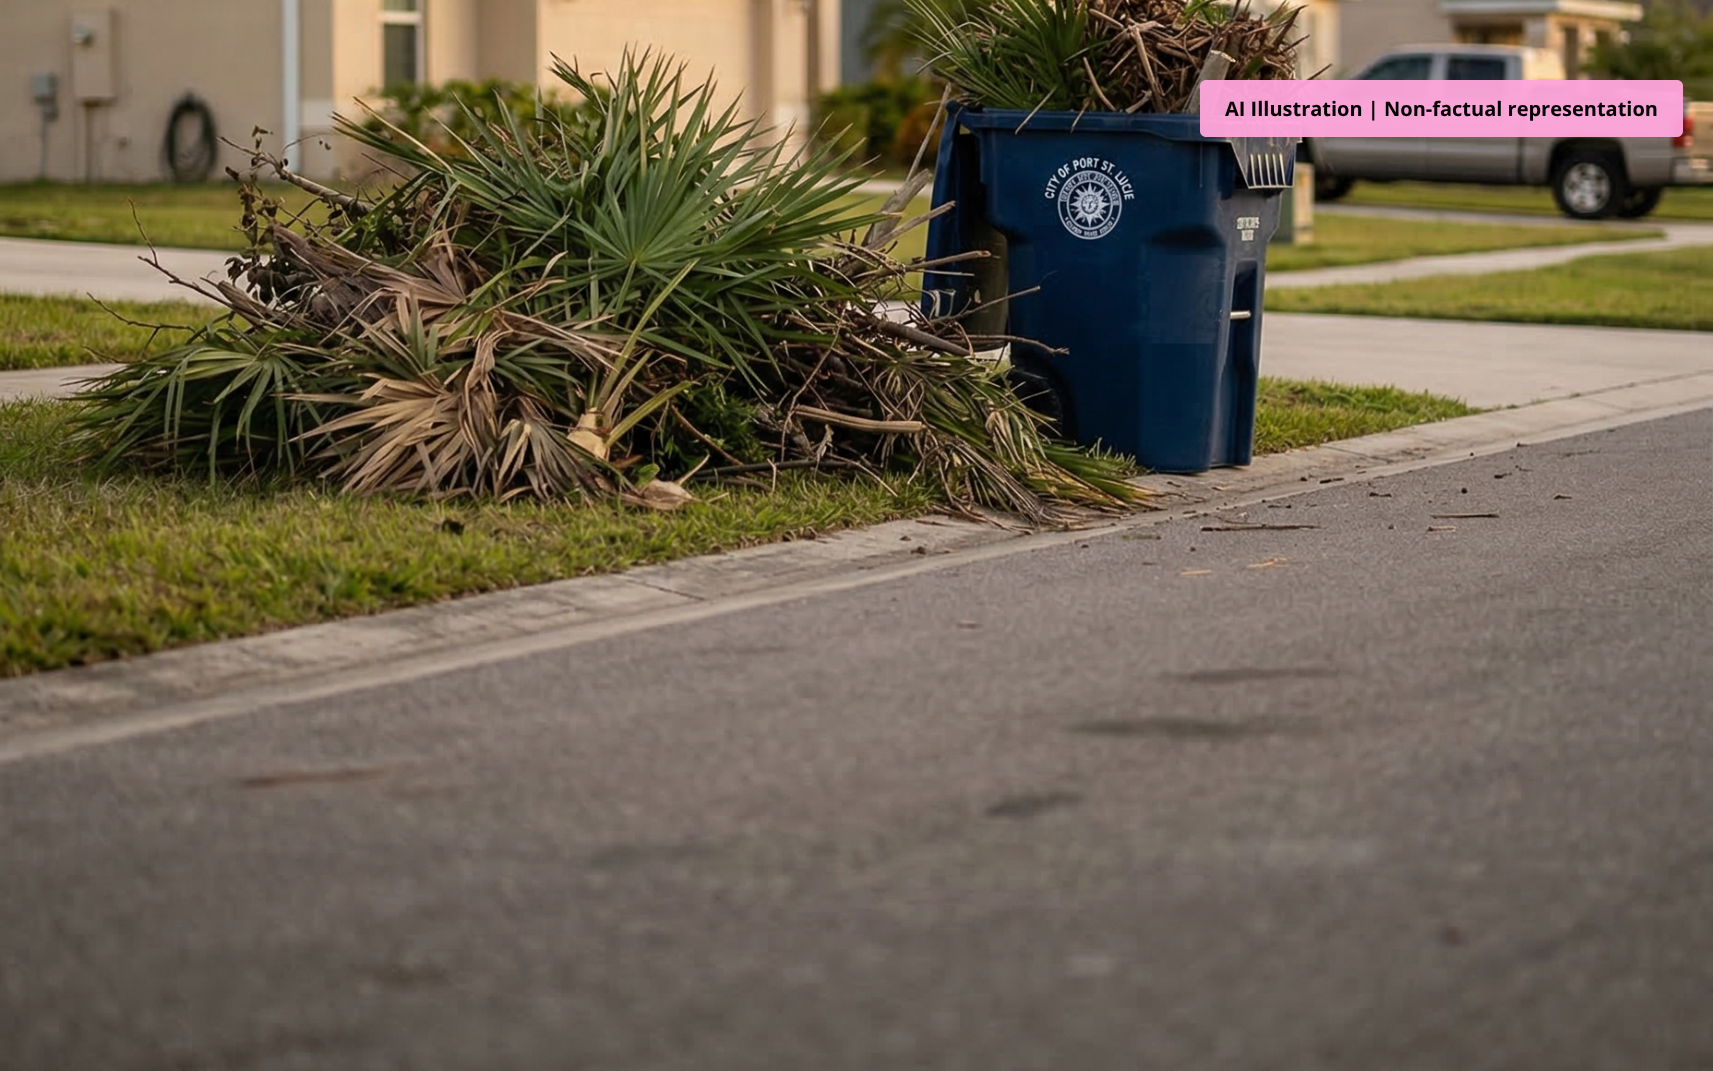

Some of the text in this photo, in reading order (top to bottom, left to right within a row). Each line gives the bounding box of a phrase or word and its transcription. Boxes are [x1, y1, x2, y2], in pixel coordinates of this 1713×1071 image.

[1045, 174, 1060, 199] CITY
[1057, 163, 1070, 178] OF
[1072, 157, 1100, 171] PORT
[1101, 160, 1115, 175] ST.
[1114, 170, 1135, 200] LUCIE
